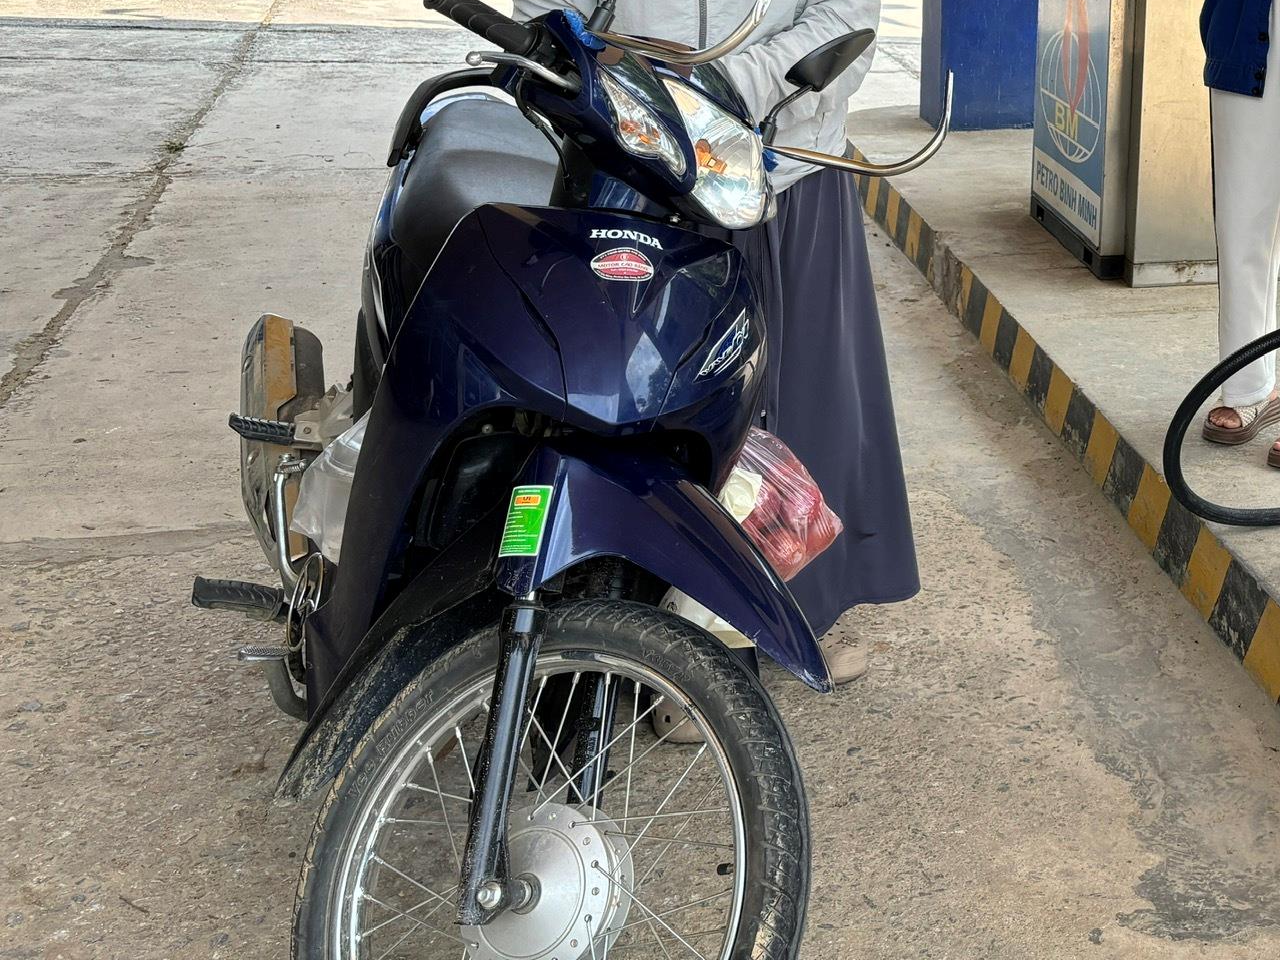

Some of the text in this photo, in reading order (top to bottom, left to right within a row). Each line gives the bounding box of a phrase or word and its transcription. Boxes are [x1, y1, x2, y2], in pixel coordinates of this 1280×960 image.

[1055, 101, 1078, 141] BM
[1036, 160, 1097, 230] PETRO BINH MINH
[589, 228, 663, 250] HONDA
